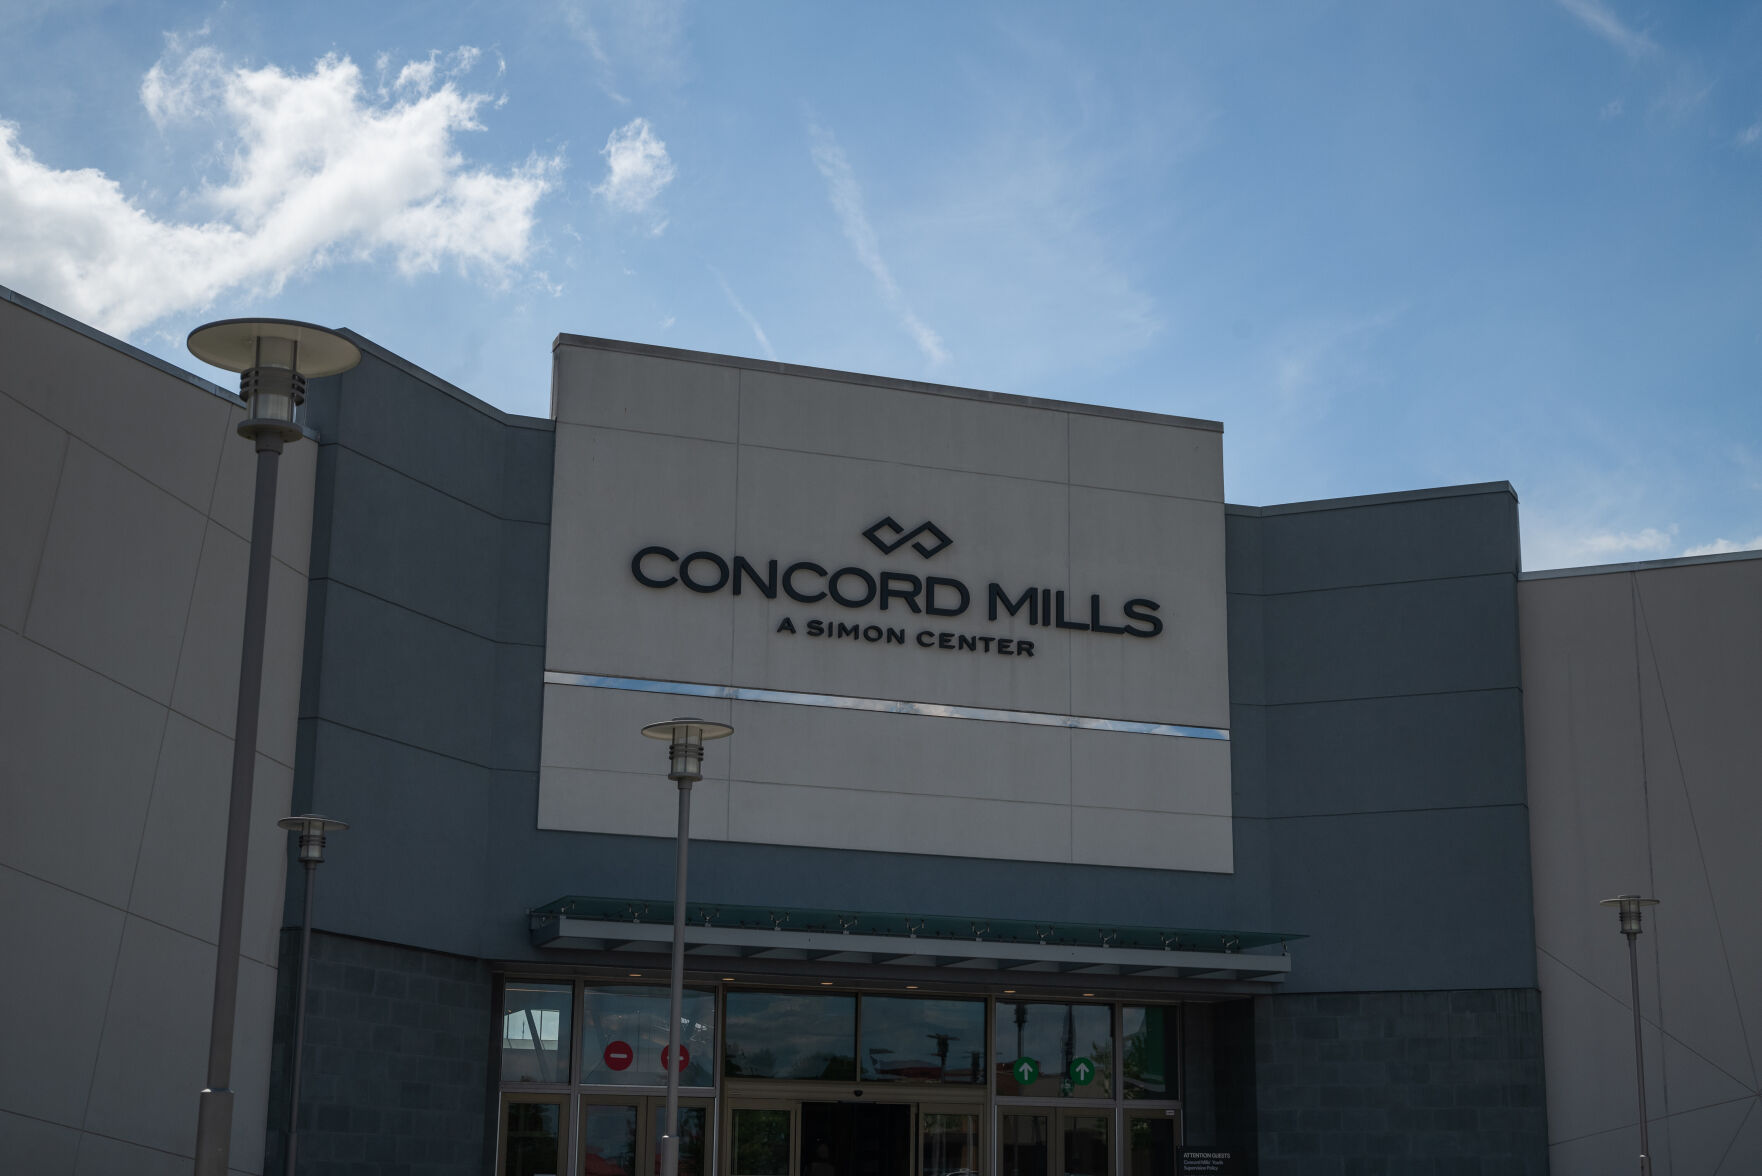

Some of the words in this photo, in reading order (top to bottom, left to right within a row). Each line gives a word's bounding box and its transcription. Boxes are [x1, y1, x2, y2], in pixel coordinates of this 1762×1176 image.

[630, 545, 971, 618] CONCORD
[987, 582, 1164, 639] MILLS
[776, 616, 797, 635] A
[805, 619, 906, 646] SIMON
[915, 630, 1035, 658] CENTER
